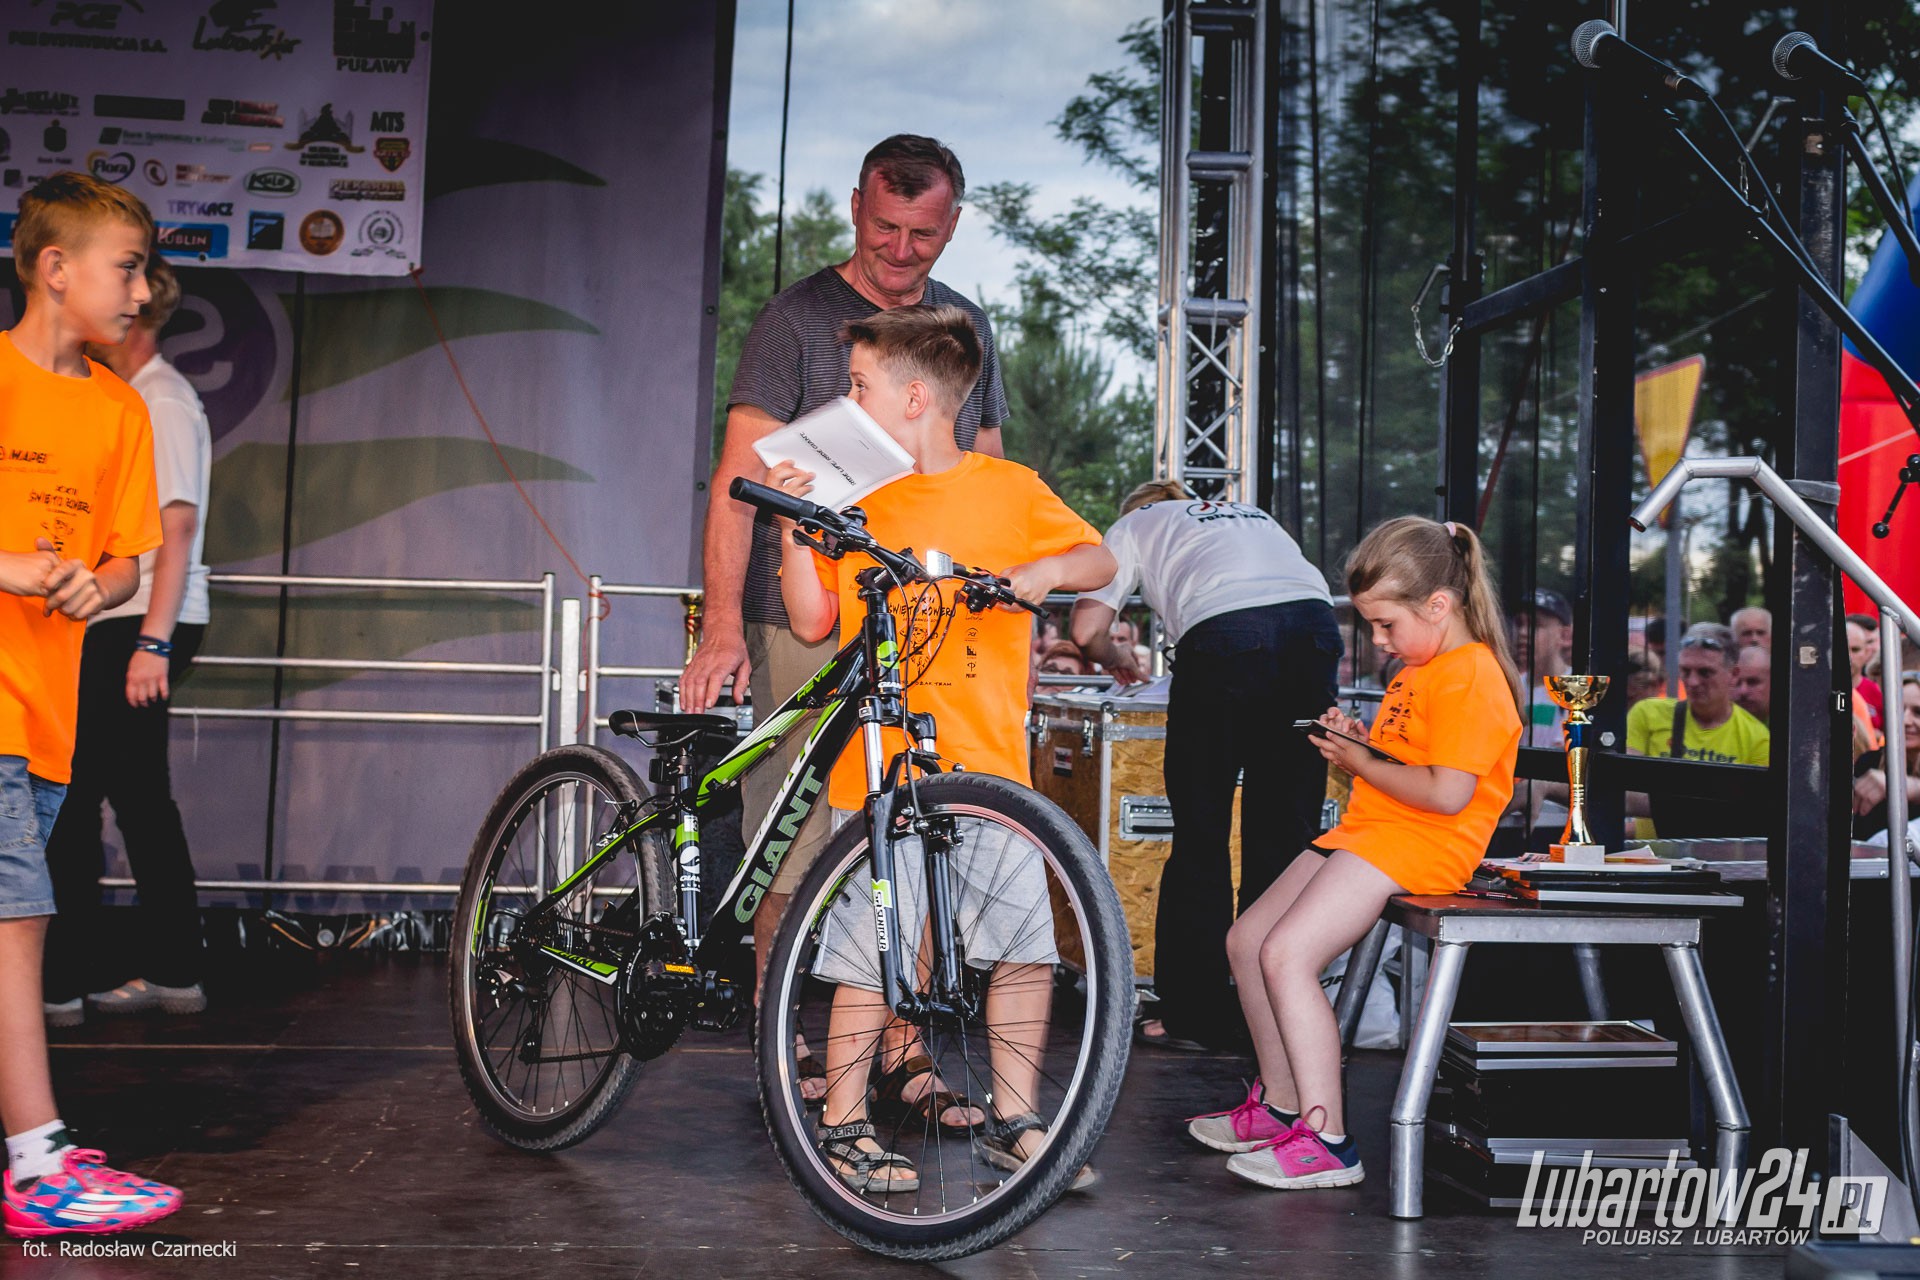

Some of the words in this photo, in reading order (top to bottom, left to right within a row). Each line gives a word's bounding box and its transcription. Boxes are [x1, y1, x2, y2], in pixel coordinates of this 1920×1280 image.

[337, 57, 411, 74] PUŁAWY
[369, 110, 405, 132] MTS
[93, 158, 129, 175] Flora
[167, 200, 234, 217] TRYKACZ
[796, 660, 838, 702] REVEL
[734, 764, 824, 924] GIANT
